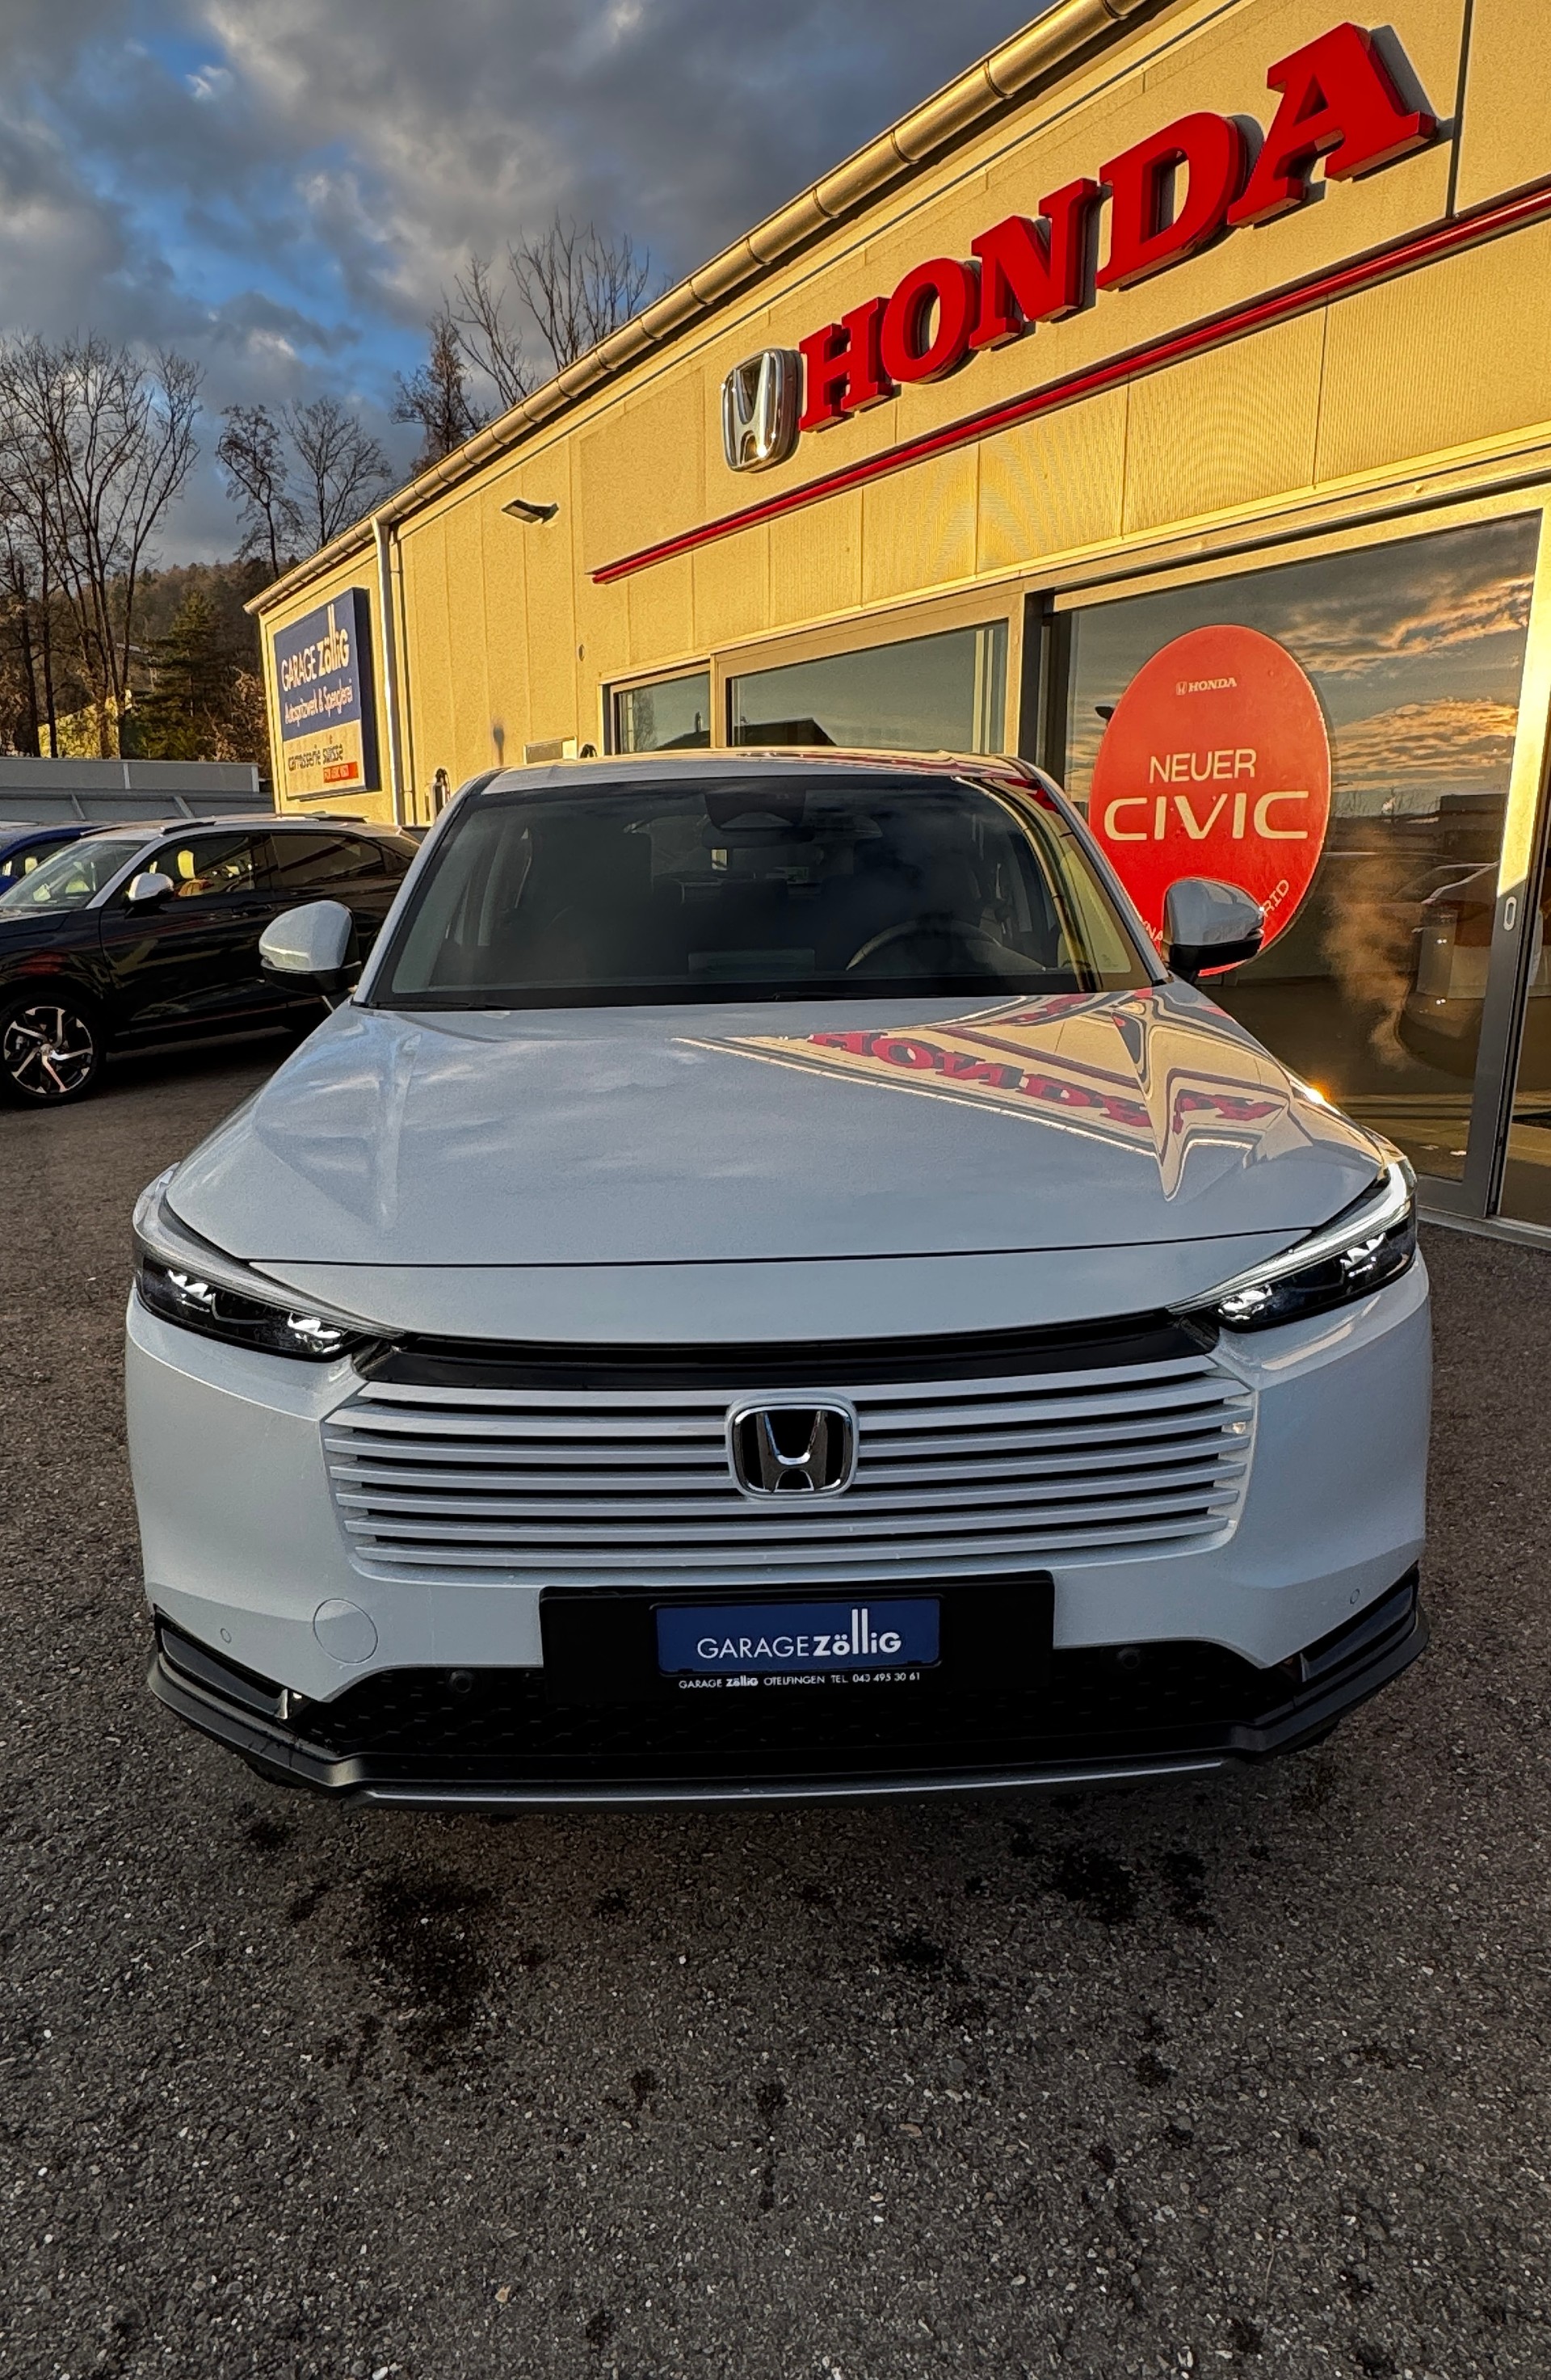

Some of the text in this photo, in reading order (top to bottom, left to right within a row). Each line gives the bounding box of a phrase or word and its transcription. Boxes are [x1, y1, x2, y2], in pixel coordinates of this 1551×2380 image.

[800, 23, 1435, 432] HONDA
[281, 645, 317, 691] GARAGE
[1188, 677, 1237, 692] HONDA
[1150, 748, 1257, 784] NEUER
[1104, 791, 1309, 841] CIVIC
[1263, 879, 1289, 918] RID
[679, 1679, 722, 1689] GARAGE
[763, 1675, 826, 1687] OTELFINGEN
[873, 1671, 891, 1683] 495
[894, 1671, 906, 1682] 30
[910, 1671, 921, 1681] 61
